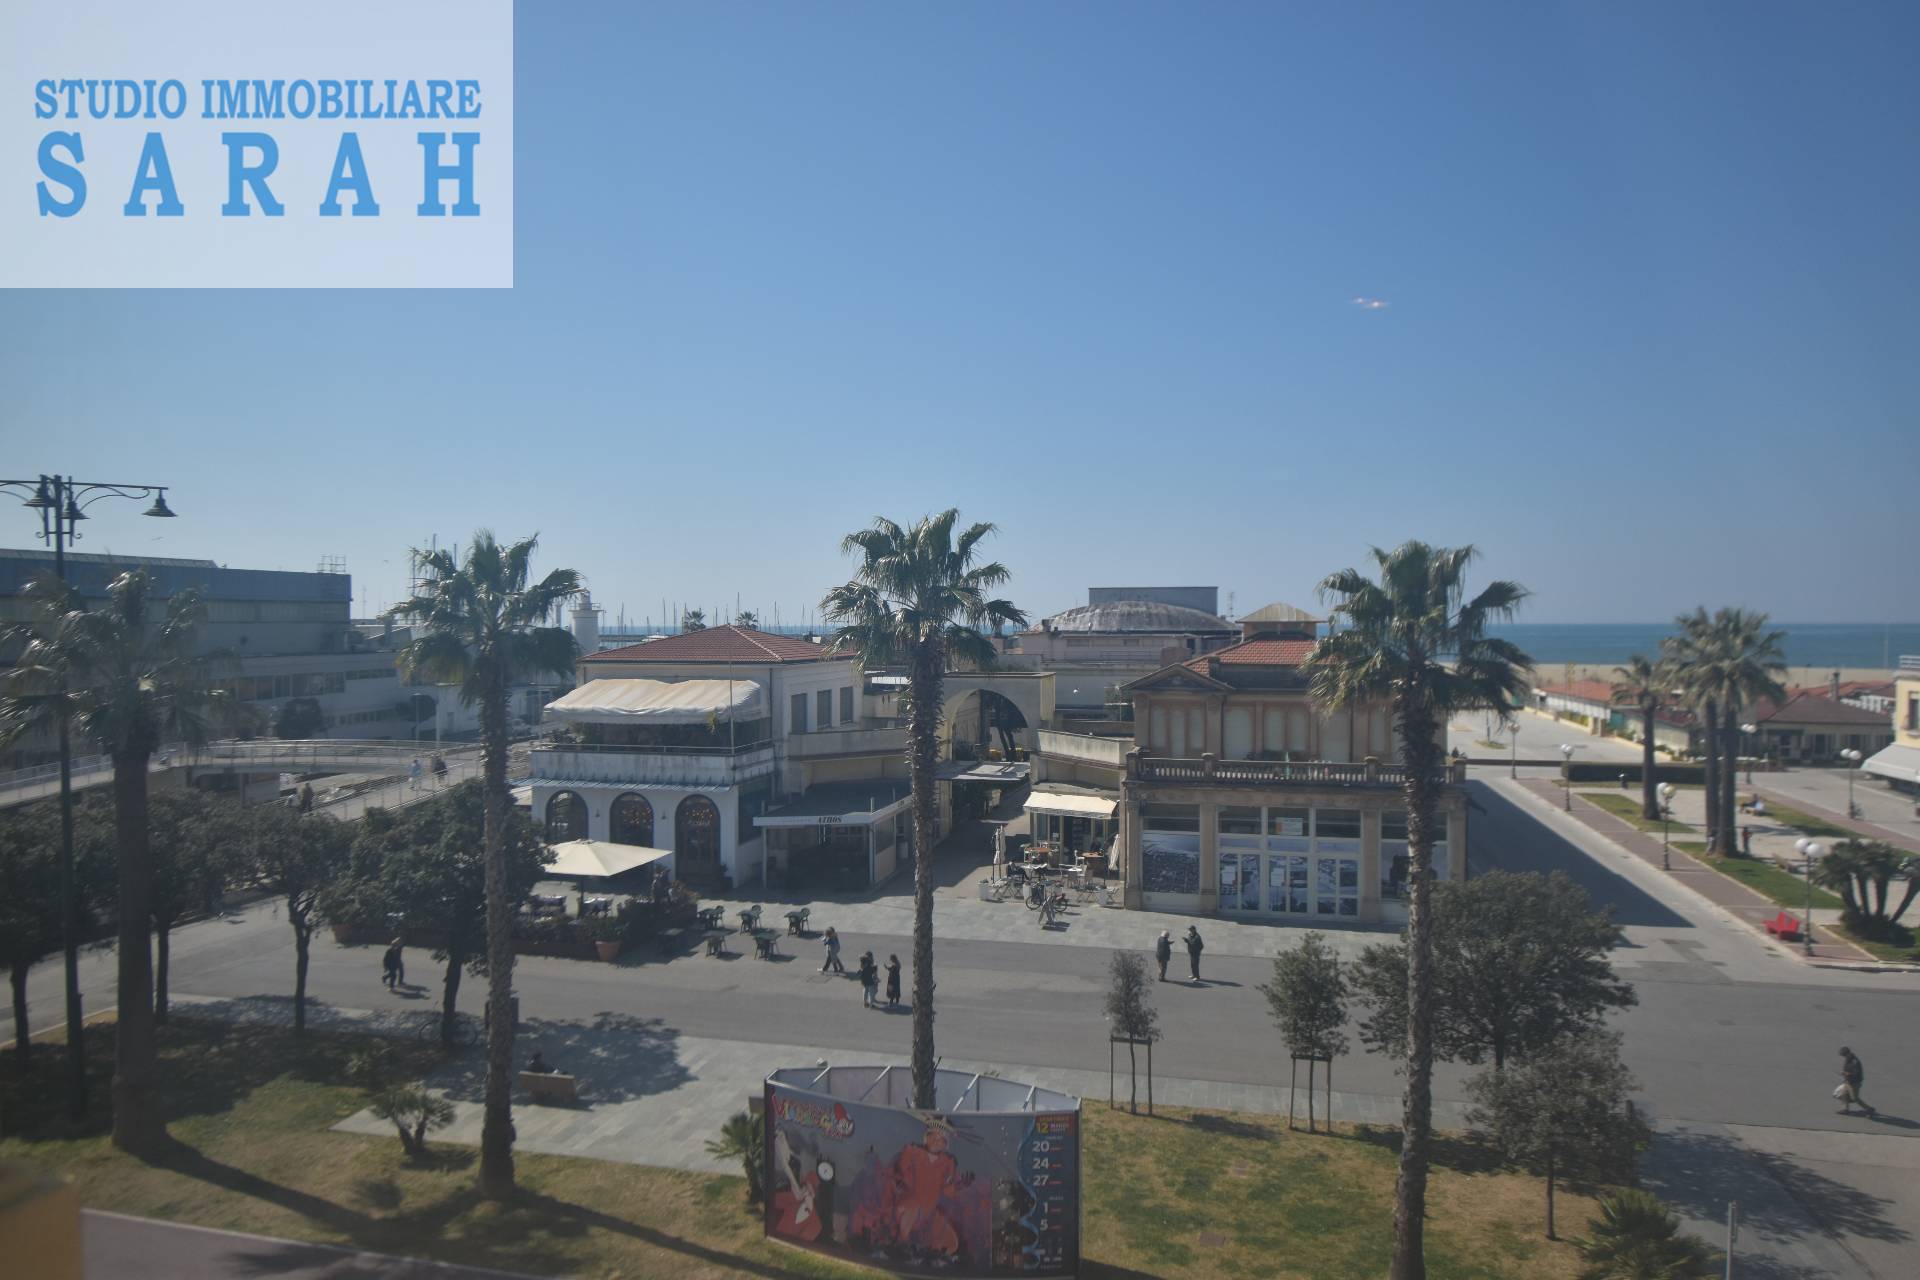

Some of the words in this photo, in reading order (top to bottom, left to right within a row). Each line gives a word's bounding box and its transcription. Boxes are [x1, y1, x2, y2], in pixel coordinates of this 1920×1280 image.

[1036, 1122, 1049, 1133] 12
[1032, 1140, 1050, 1153] 20
[1033, 1157, 1049, 1169] 24
[1033, 1174, 1049, 1186] 27
[1043, 1201, 1048, 1214] 1
[1040, 1218, 1048, 1231] 5
